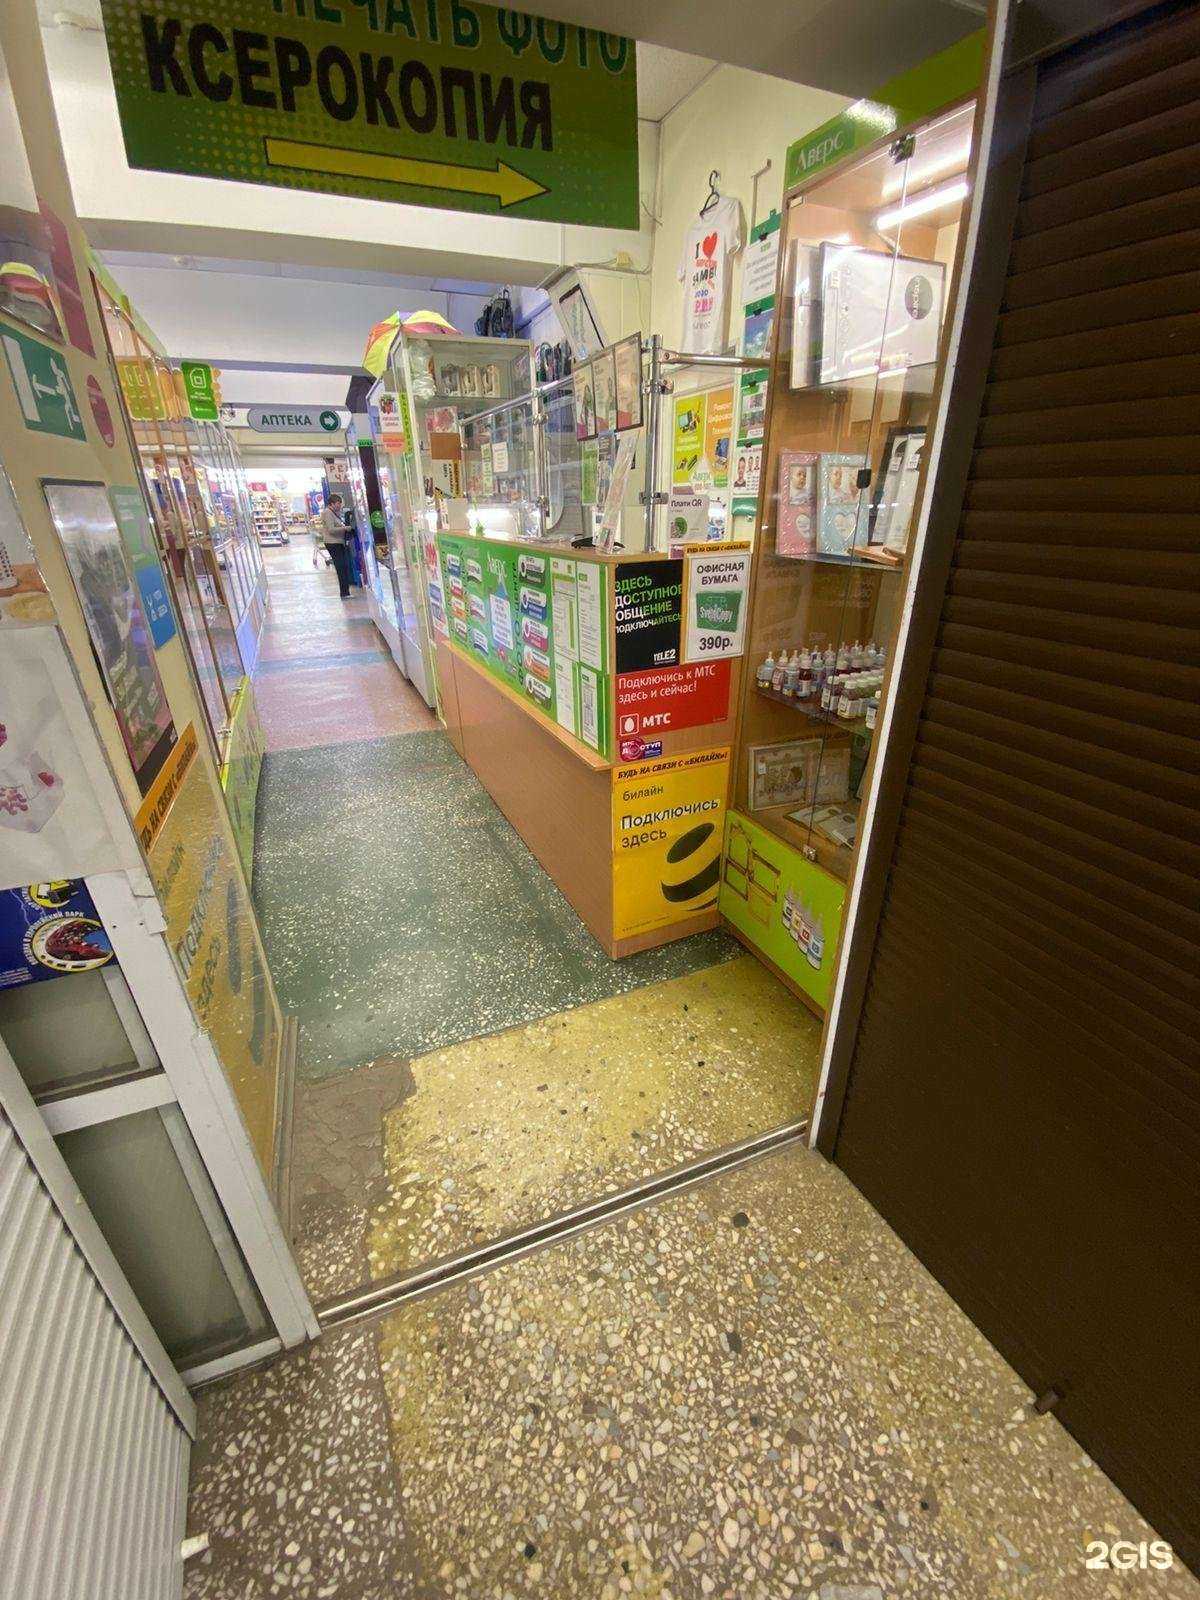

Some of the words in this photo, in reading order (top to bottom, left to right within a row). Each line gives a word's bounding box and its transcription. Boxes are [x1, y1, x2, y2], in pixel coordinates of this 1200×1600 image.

[141, 15, 553, 152] КСЕРОКОПИЯ
[261, 414, 312, 426] АПТЕКА
[691, 499, 702, 507] QR
[697, 562, 744, 574] ОФИСНАЯ
[615, 576, 652, 593] ЗДЕСЬ
[701, 574, 738, 585] БУМАГА
[615, 600, 672, 622] ОБЩЕНИЕ
[699, 636, 733, 650] 390р.
[653, 648, 676, 661] TELE2
[619, 672, 683, 690] Подключись
[686, 670, 692, 679] к
[694, 665, 716, 678] МТС
[618, 691, 648, 704] здесь
[651, 690, 657, 698] и
[660, 680, 697, 697] сейчас!
[642, 712, 671, 728] МТС
[618, 768, 638, 779] БУДЬ
[639, 767, 651, 775] НА
[652, 763, 677, 773] СВЯЗИ
[622, 786, 664, 801] билайн
[622, 800, 718, 830] Подключись
[621, 829, 667, 848] здесь
